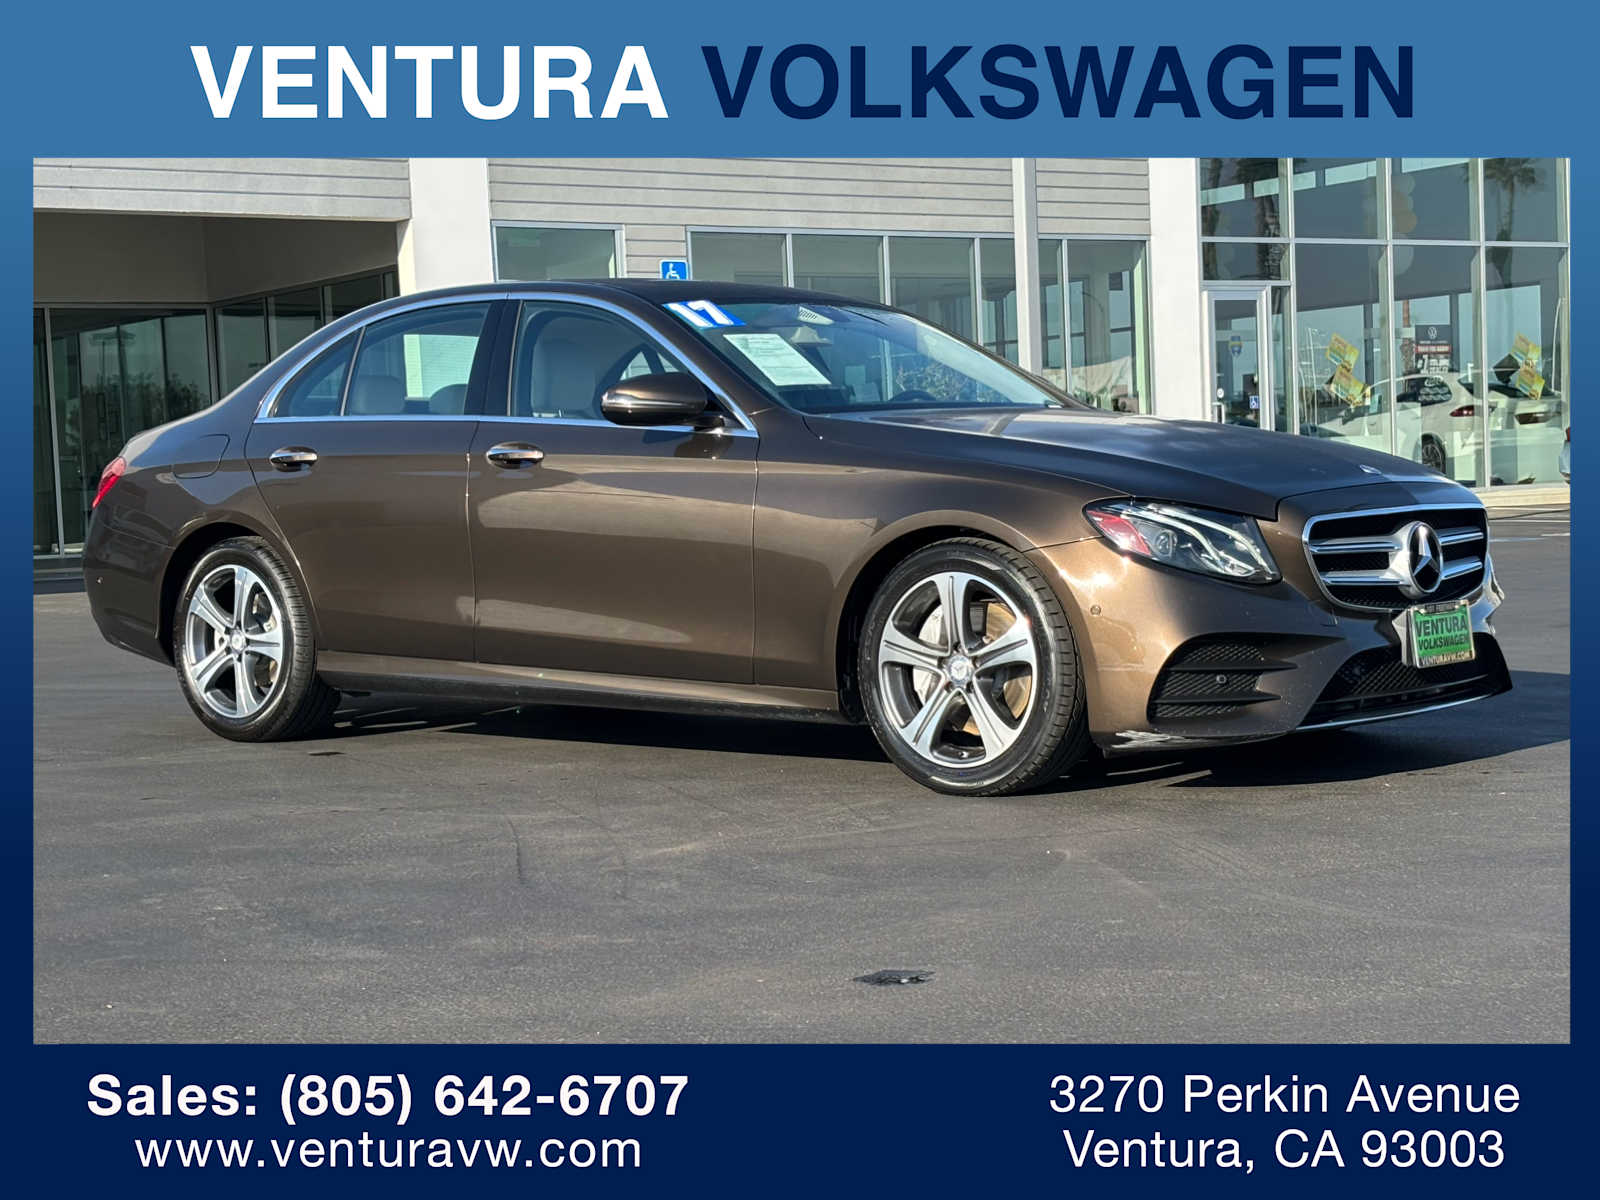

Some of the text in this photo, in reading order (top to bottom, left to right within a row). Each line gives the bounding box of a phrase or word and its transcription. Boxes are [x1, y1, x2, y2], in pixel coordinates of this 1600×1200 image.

[667, 300, 735, 328] 17
[1415, 615, 1468, 637] VENTURA
[1418, 634, 1471, 650] VOLKSWAGEN
